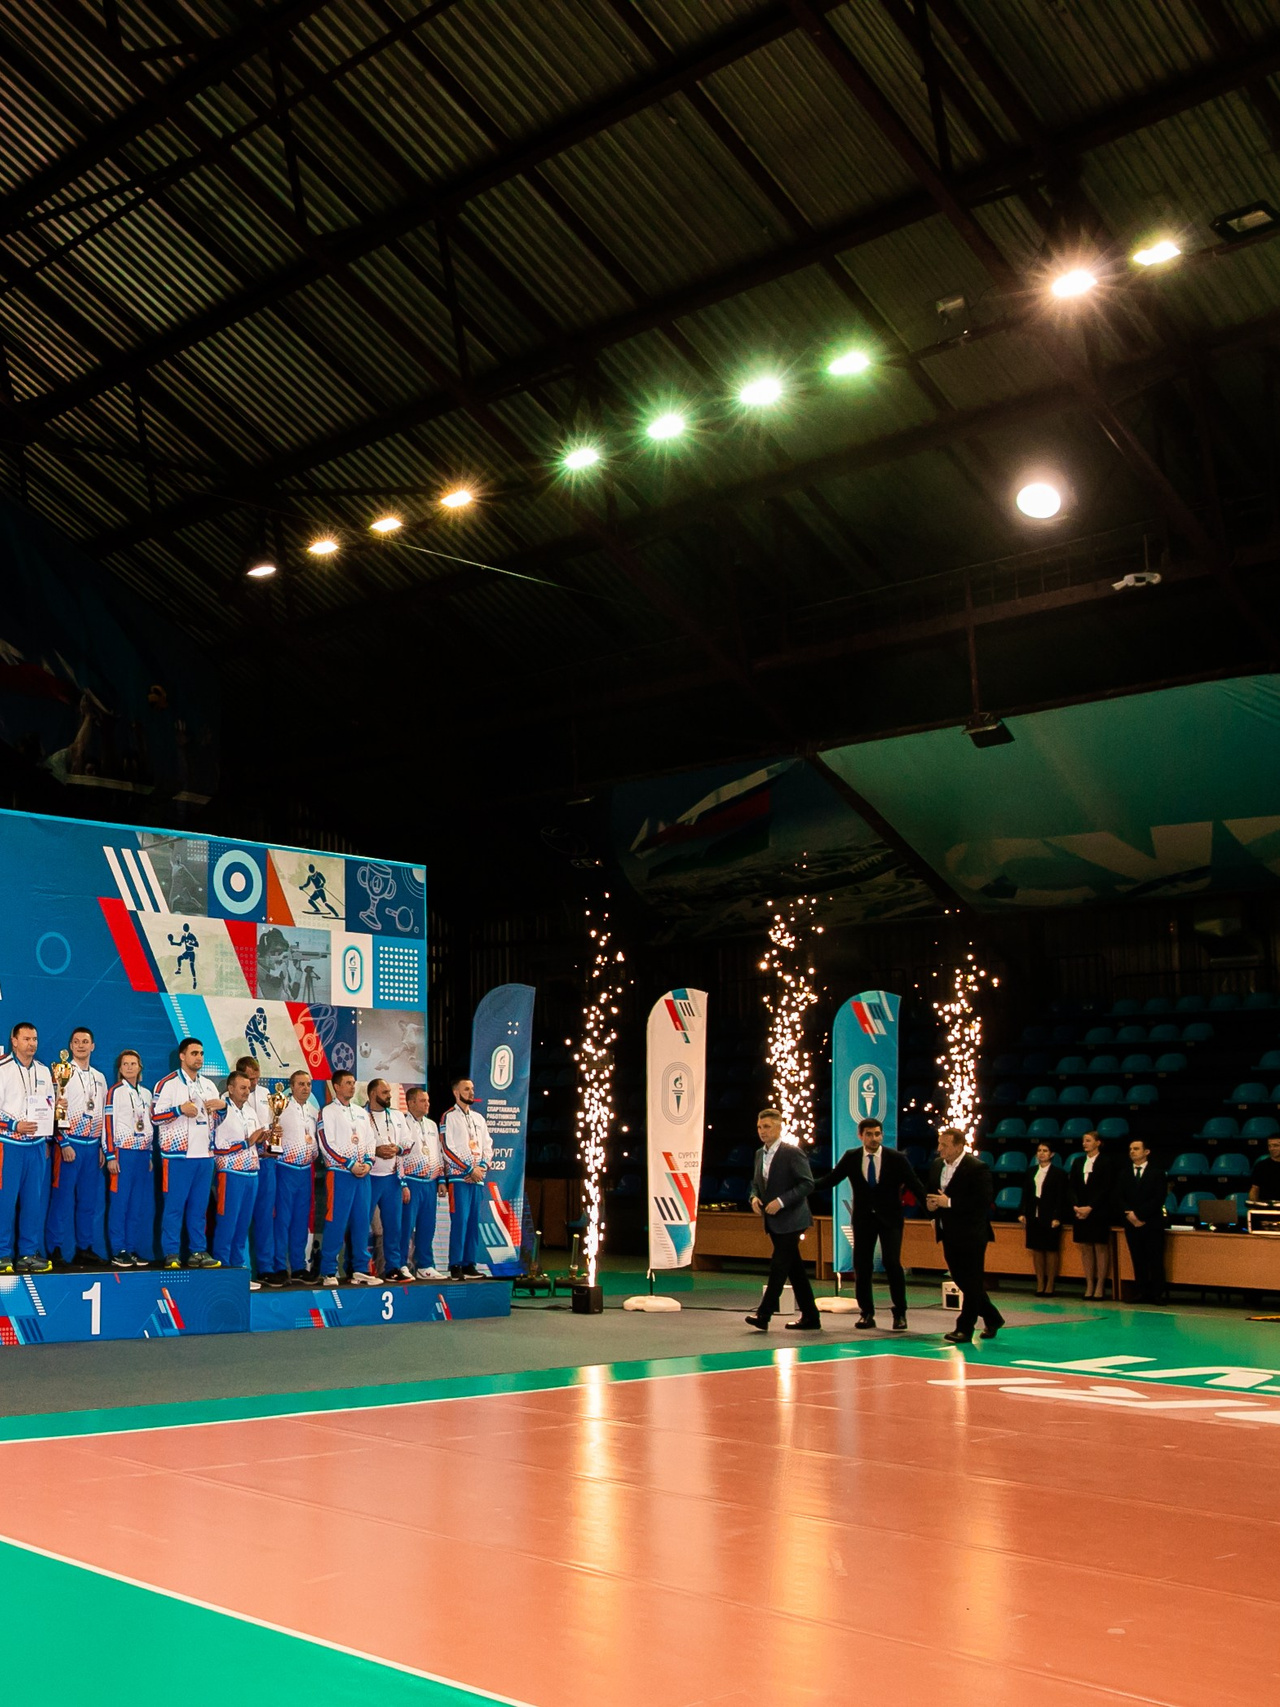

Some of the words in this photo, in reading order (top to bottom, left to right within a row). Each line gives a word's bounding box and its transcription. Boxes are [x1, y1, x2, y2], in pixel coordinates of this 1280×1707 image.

[493, 1148, 513, 1157] РГУТ
[490, 1161, 506, 1170] 023
[82, 1281, 101, 1335] 1
[381, 1291, 394, 1320] 3
